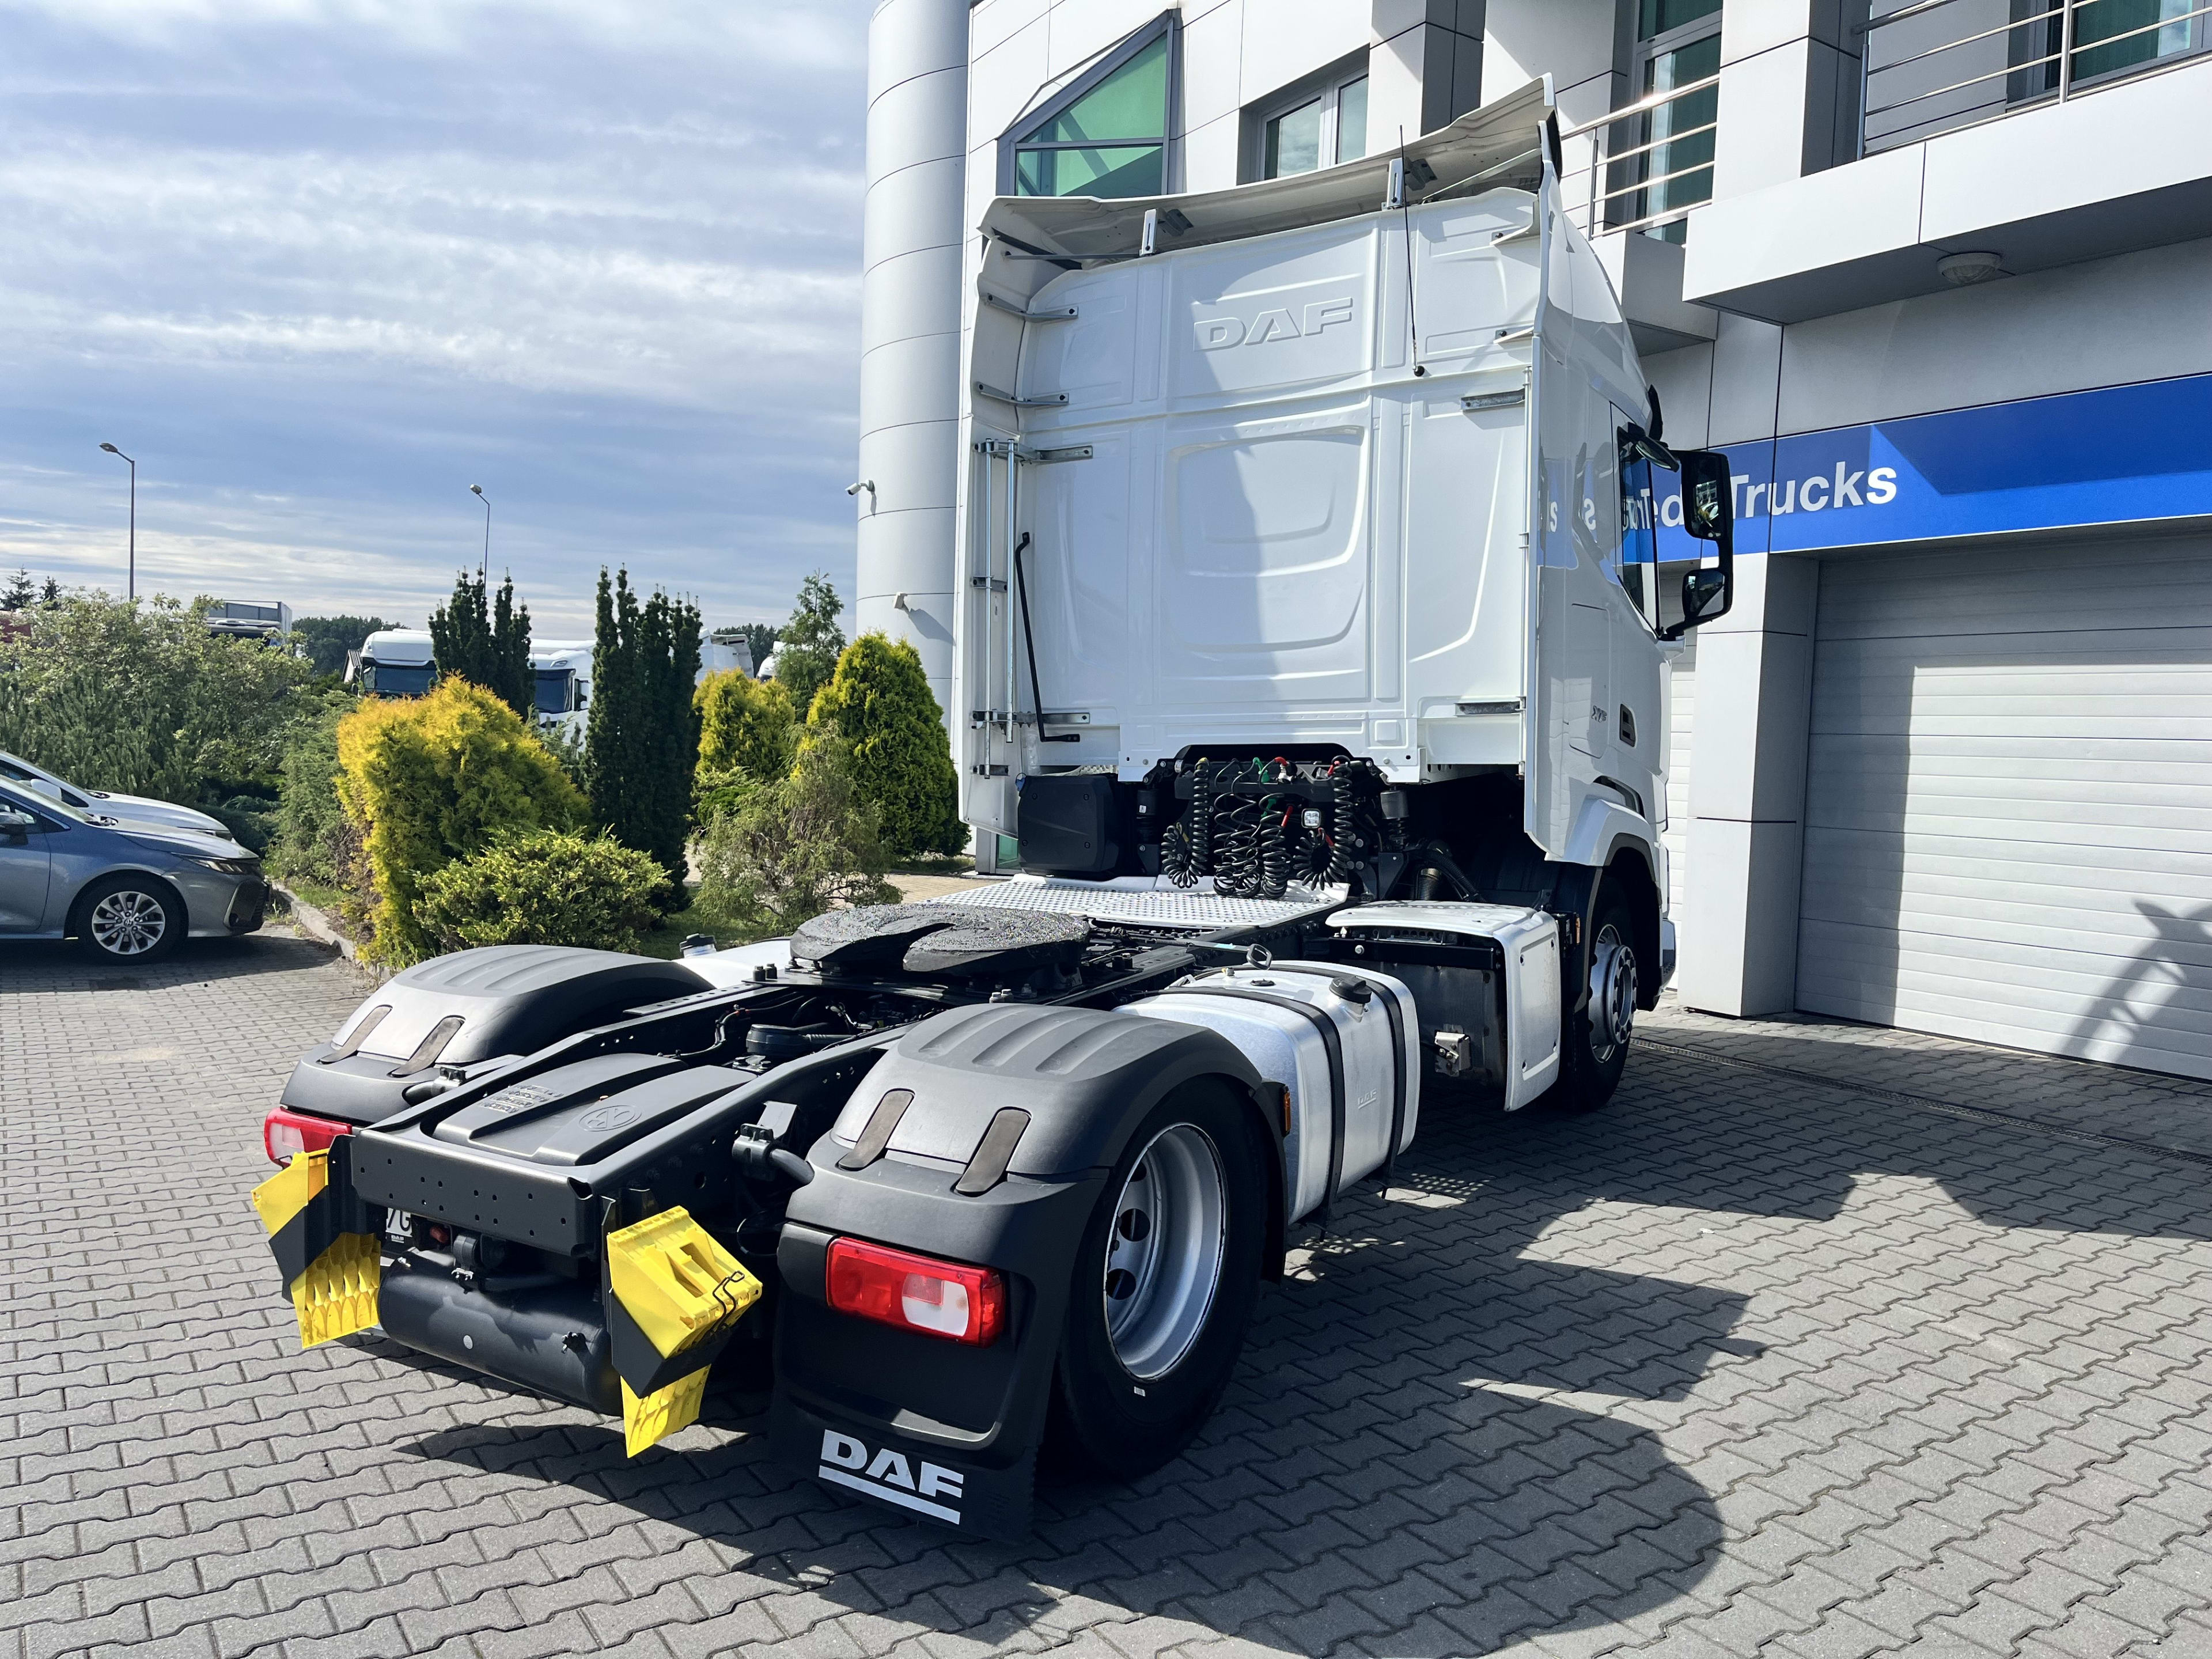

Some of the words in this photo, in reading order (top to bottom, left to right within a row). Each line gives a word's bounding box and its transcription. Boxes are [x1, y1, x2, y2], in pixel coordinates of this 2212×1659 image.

[1194, 297, 1353, 353] DAF
[1730, 461, 1897, 520] Trucks
[820, 1429, 964, 1498] DAF
